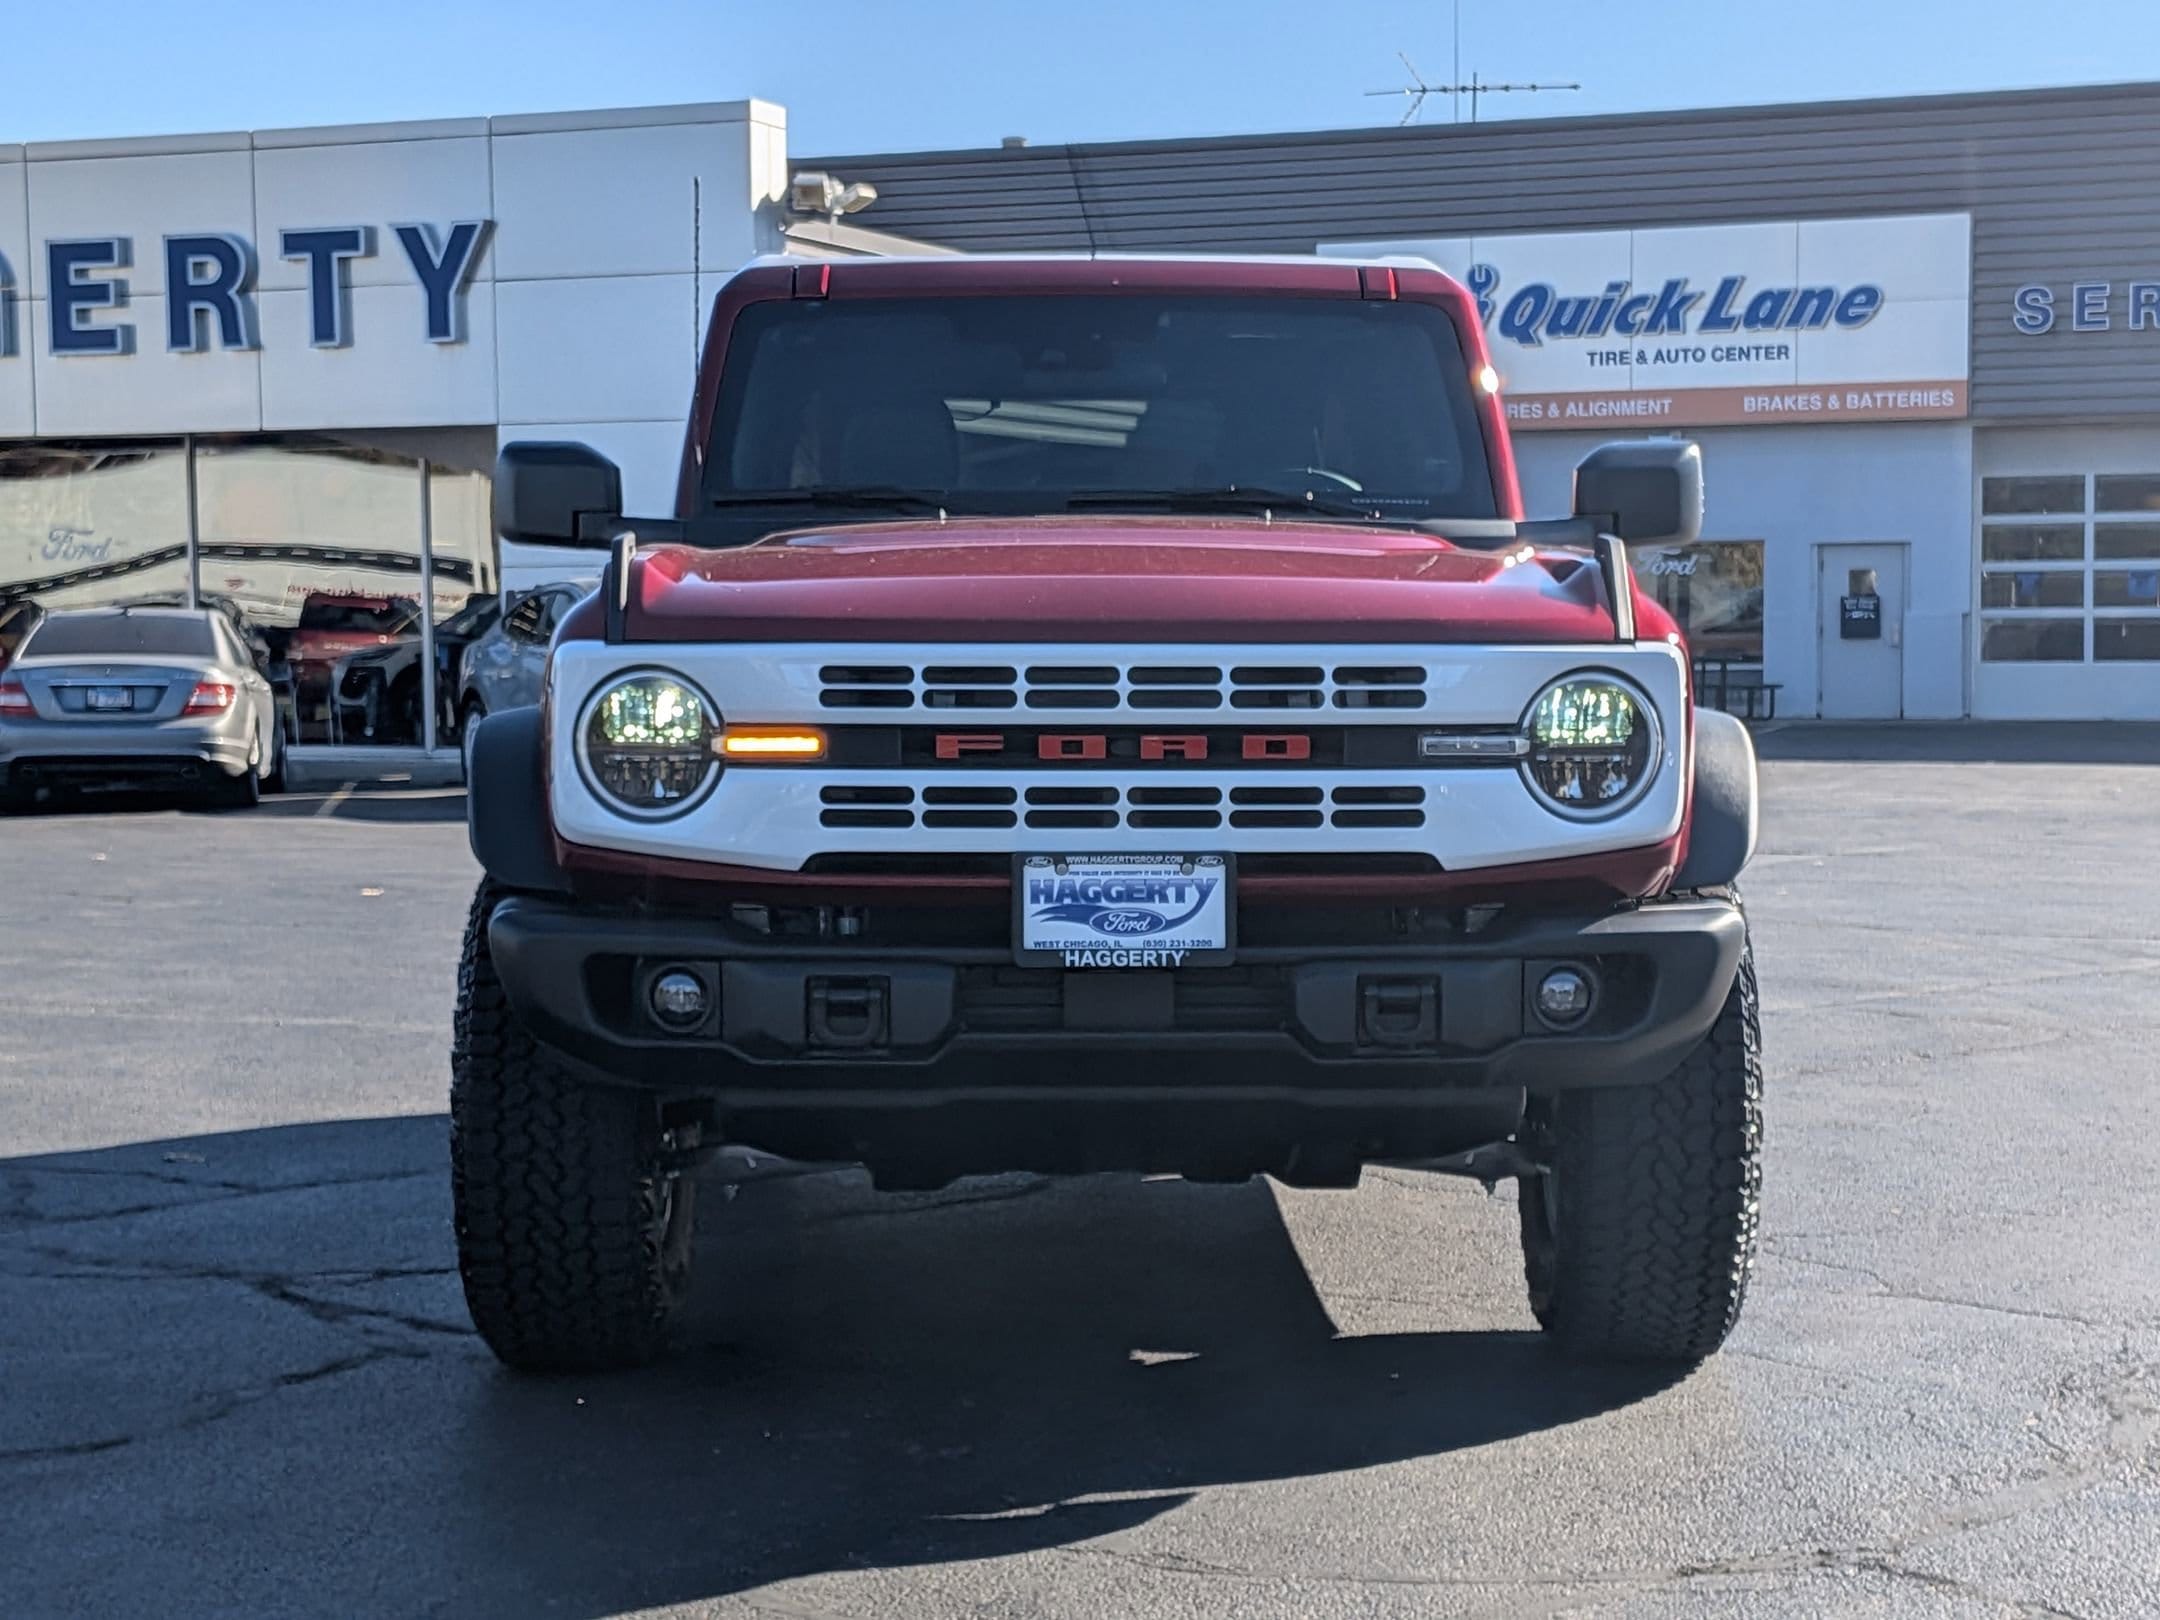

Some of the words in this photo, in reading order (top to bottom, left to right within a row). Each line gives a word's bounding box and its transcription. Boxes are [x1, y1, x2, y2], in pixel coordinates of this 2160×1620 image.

[0, 221, 492, 356] ERTY
[1500, 277, 1702, 348] Quick
[1698, 275, 1884, 334] Lane
[2013, 282, 2160, 335] SER
[1587, 350, 1632, 367] TIRE
[1636, 348, 1647, 365] &
[1653, 347, 1705, 365] AUTO
[1711, 344, 1790, 363] CENTER
[1548, 400, 1560, 417] &
[1566, 398, 1672, 417] ALIGNMENT
[1743, 392, 1821, 413] BRAKES
[1828, 392, 1840, 411] &
[1846, 389, 1954, 410] BATTERIES
[935, 734, 1311, 759] FORD
[1029, 878, 1218, 905] HAGGERTY
[1103, 911, 1151, 932] Ford
[1033, 940, 1060, 948] WEST
[1114, 940, 1123, 948] IL
[1065, 950, 1185, 967] HAGGERTY
